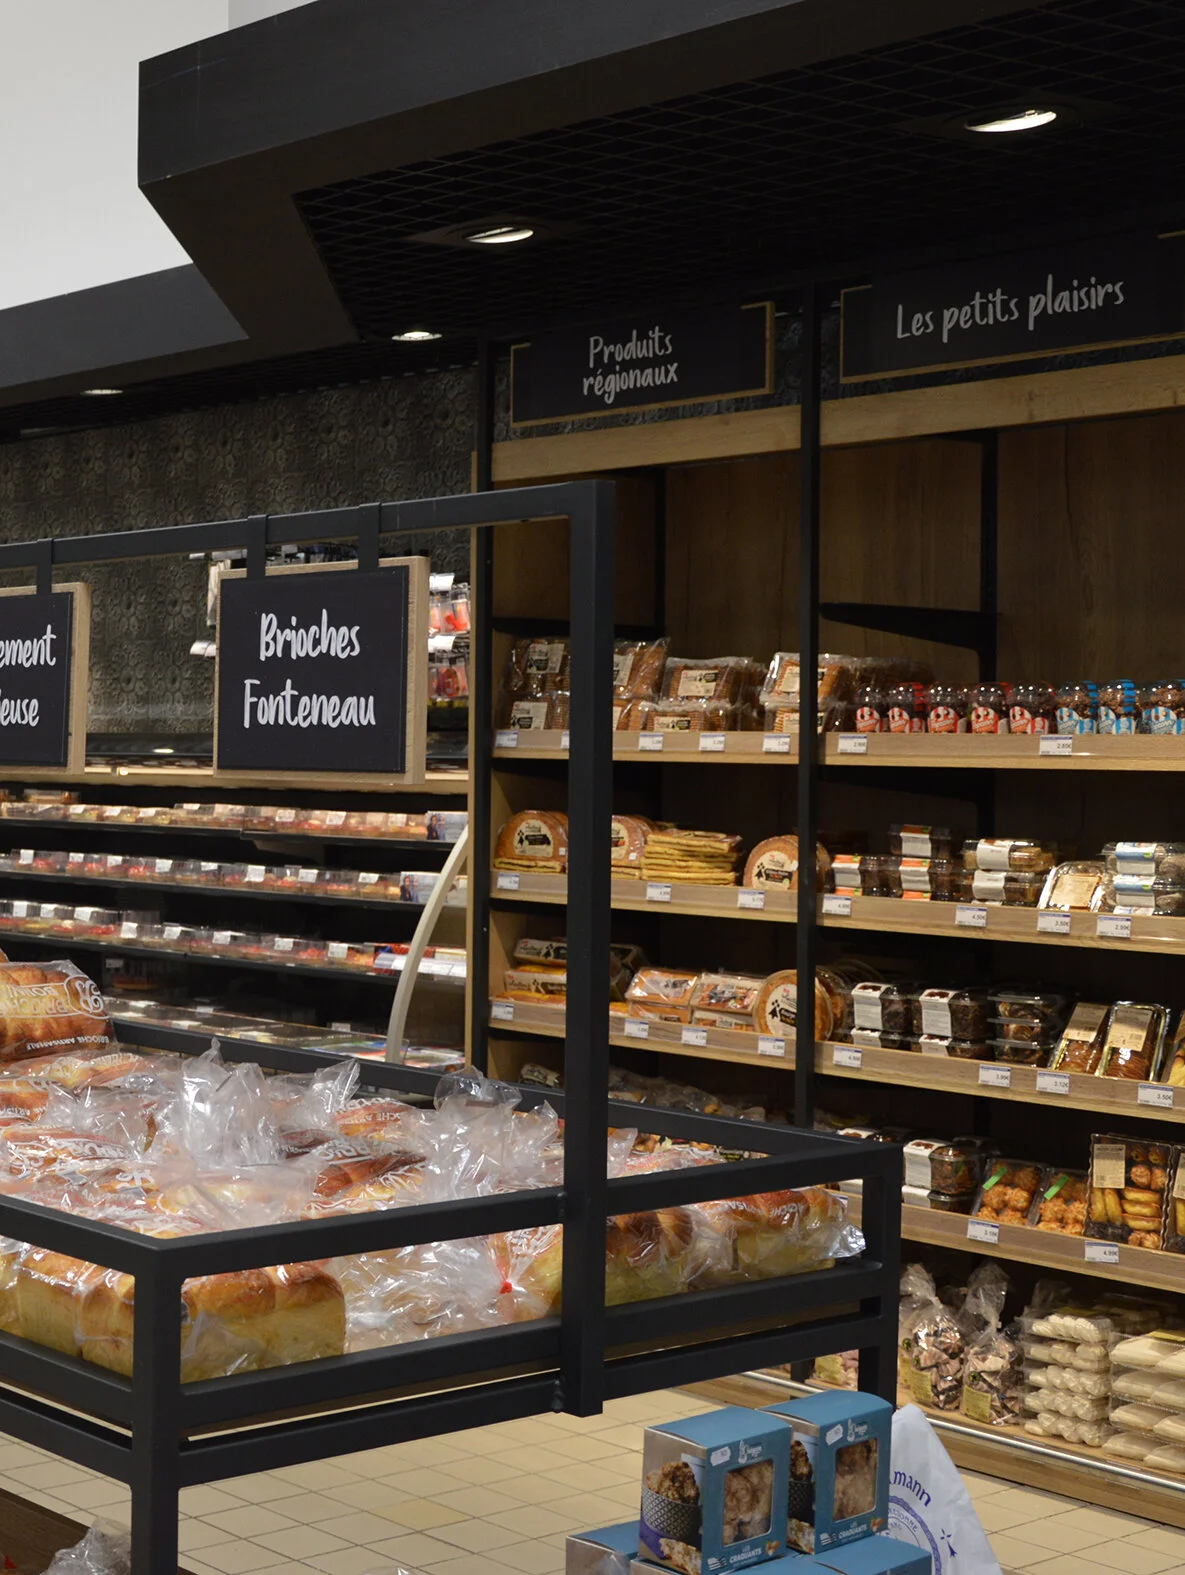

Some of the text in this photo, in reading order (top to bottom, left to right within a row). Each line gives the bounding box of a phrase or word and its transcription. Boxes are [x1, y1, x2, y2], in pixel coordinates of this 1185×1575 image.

[896, 273, 1125, 343] Les petits plaisirs
[589, 325, 673, 369] Produits
[582, 362, 679, 405] régionaux
[259, 608, 361, 661] Brioches
[243, 678, 376, 729] Fonteneau
[889, 1471, 931, 1507] mann
